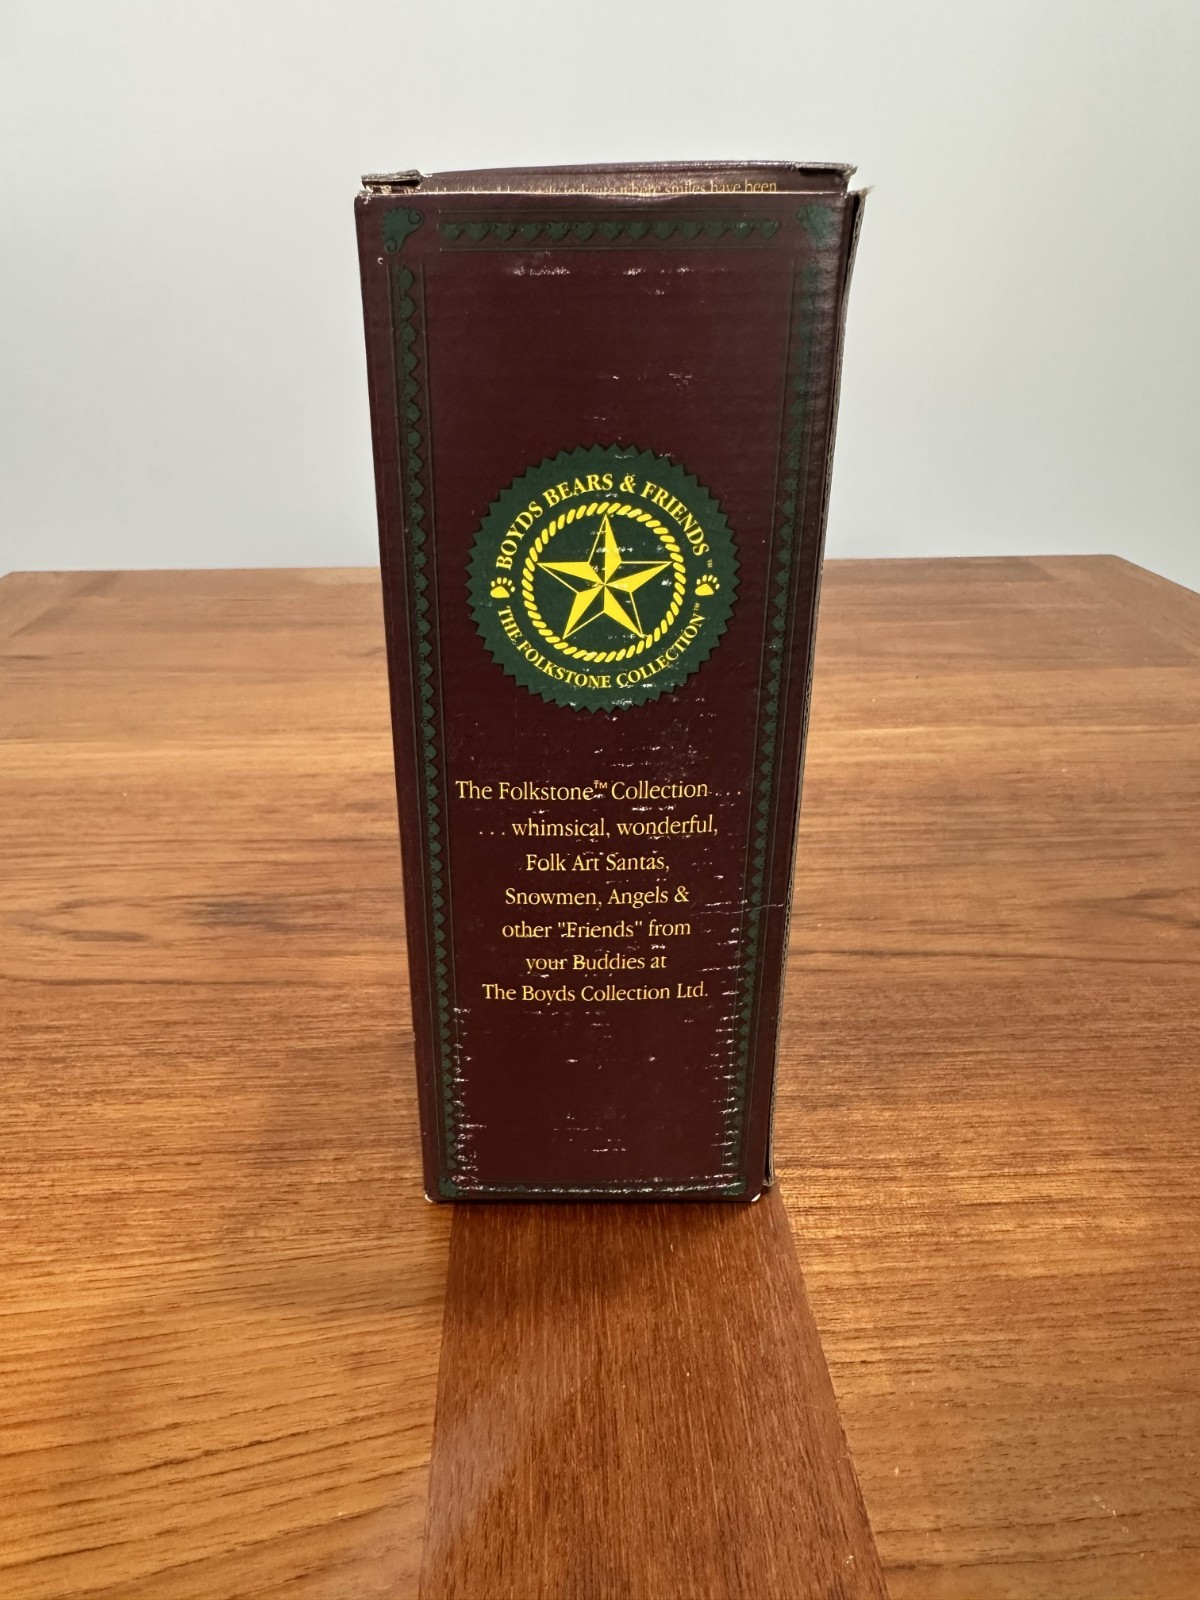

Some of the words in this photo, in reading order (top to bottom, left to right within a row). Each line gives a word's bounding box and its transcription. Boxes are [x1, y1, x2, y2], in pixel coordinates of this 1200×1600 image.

[665, 180, 706, 194] smiles
[710, 179, 741, 193] have
[744, 178, 777, 193] been
[495, 500, 544, 570] BOYDS
[542, 473, 613, 508] BEARS
[619, 474, 637, 494] &
[640, 480, 710, 556] FRIENDS
[497, 605, 523, 646] THE
[516, 641, 612, 688] FOLKSTONE
[455, 780, 492, 799] The
[612, 778, 707, 800] Collection
[512, 818, 610, 838] whimsical,
[617, 814, 717, 836] wonderful,
[526, 853, 566, 871] Folk
[572, 854, 599, 871] Art
[606, 854, 669, 872] Santas,
[506, 888, 602, 907] Snowmen,
[607, 886, 668, 908] Angels
[674, 886, 689, 902] &
[502, 921, 552, 938] other
[558, 920, 642, 938] "Friends"
[649, 919, 690, 936] from
[526, 959, 567, 972] your
[573, 953, 645, 970] Buddies
[651, 956, 667, 968] at
[482, 984, 516, 1000] The
[522, 985, 575, 1005] Boyds
[581, 985, 670, 1001] Collection
[677, 981, 707, 998] Ltd.
